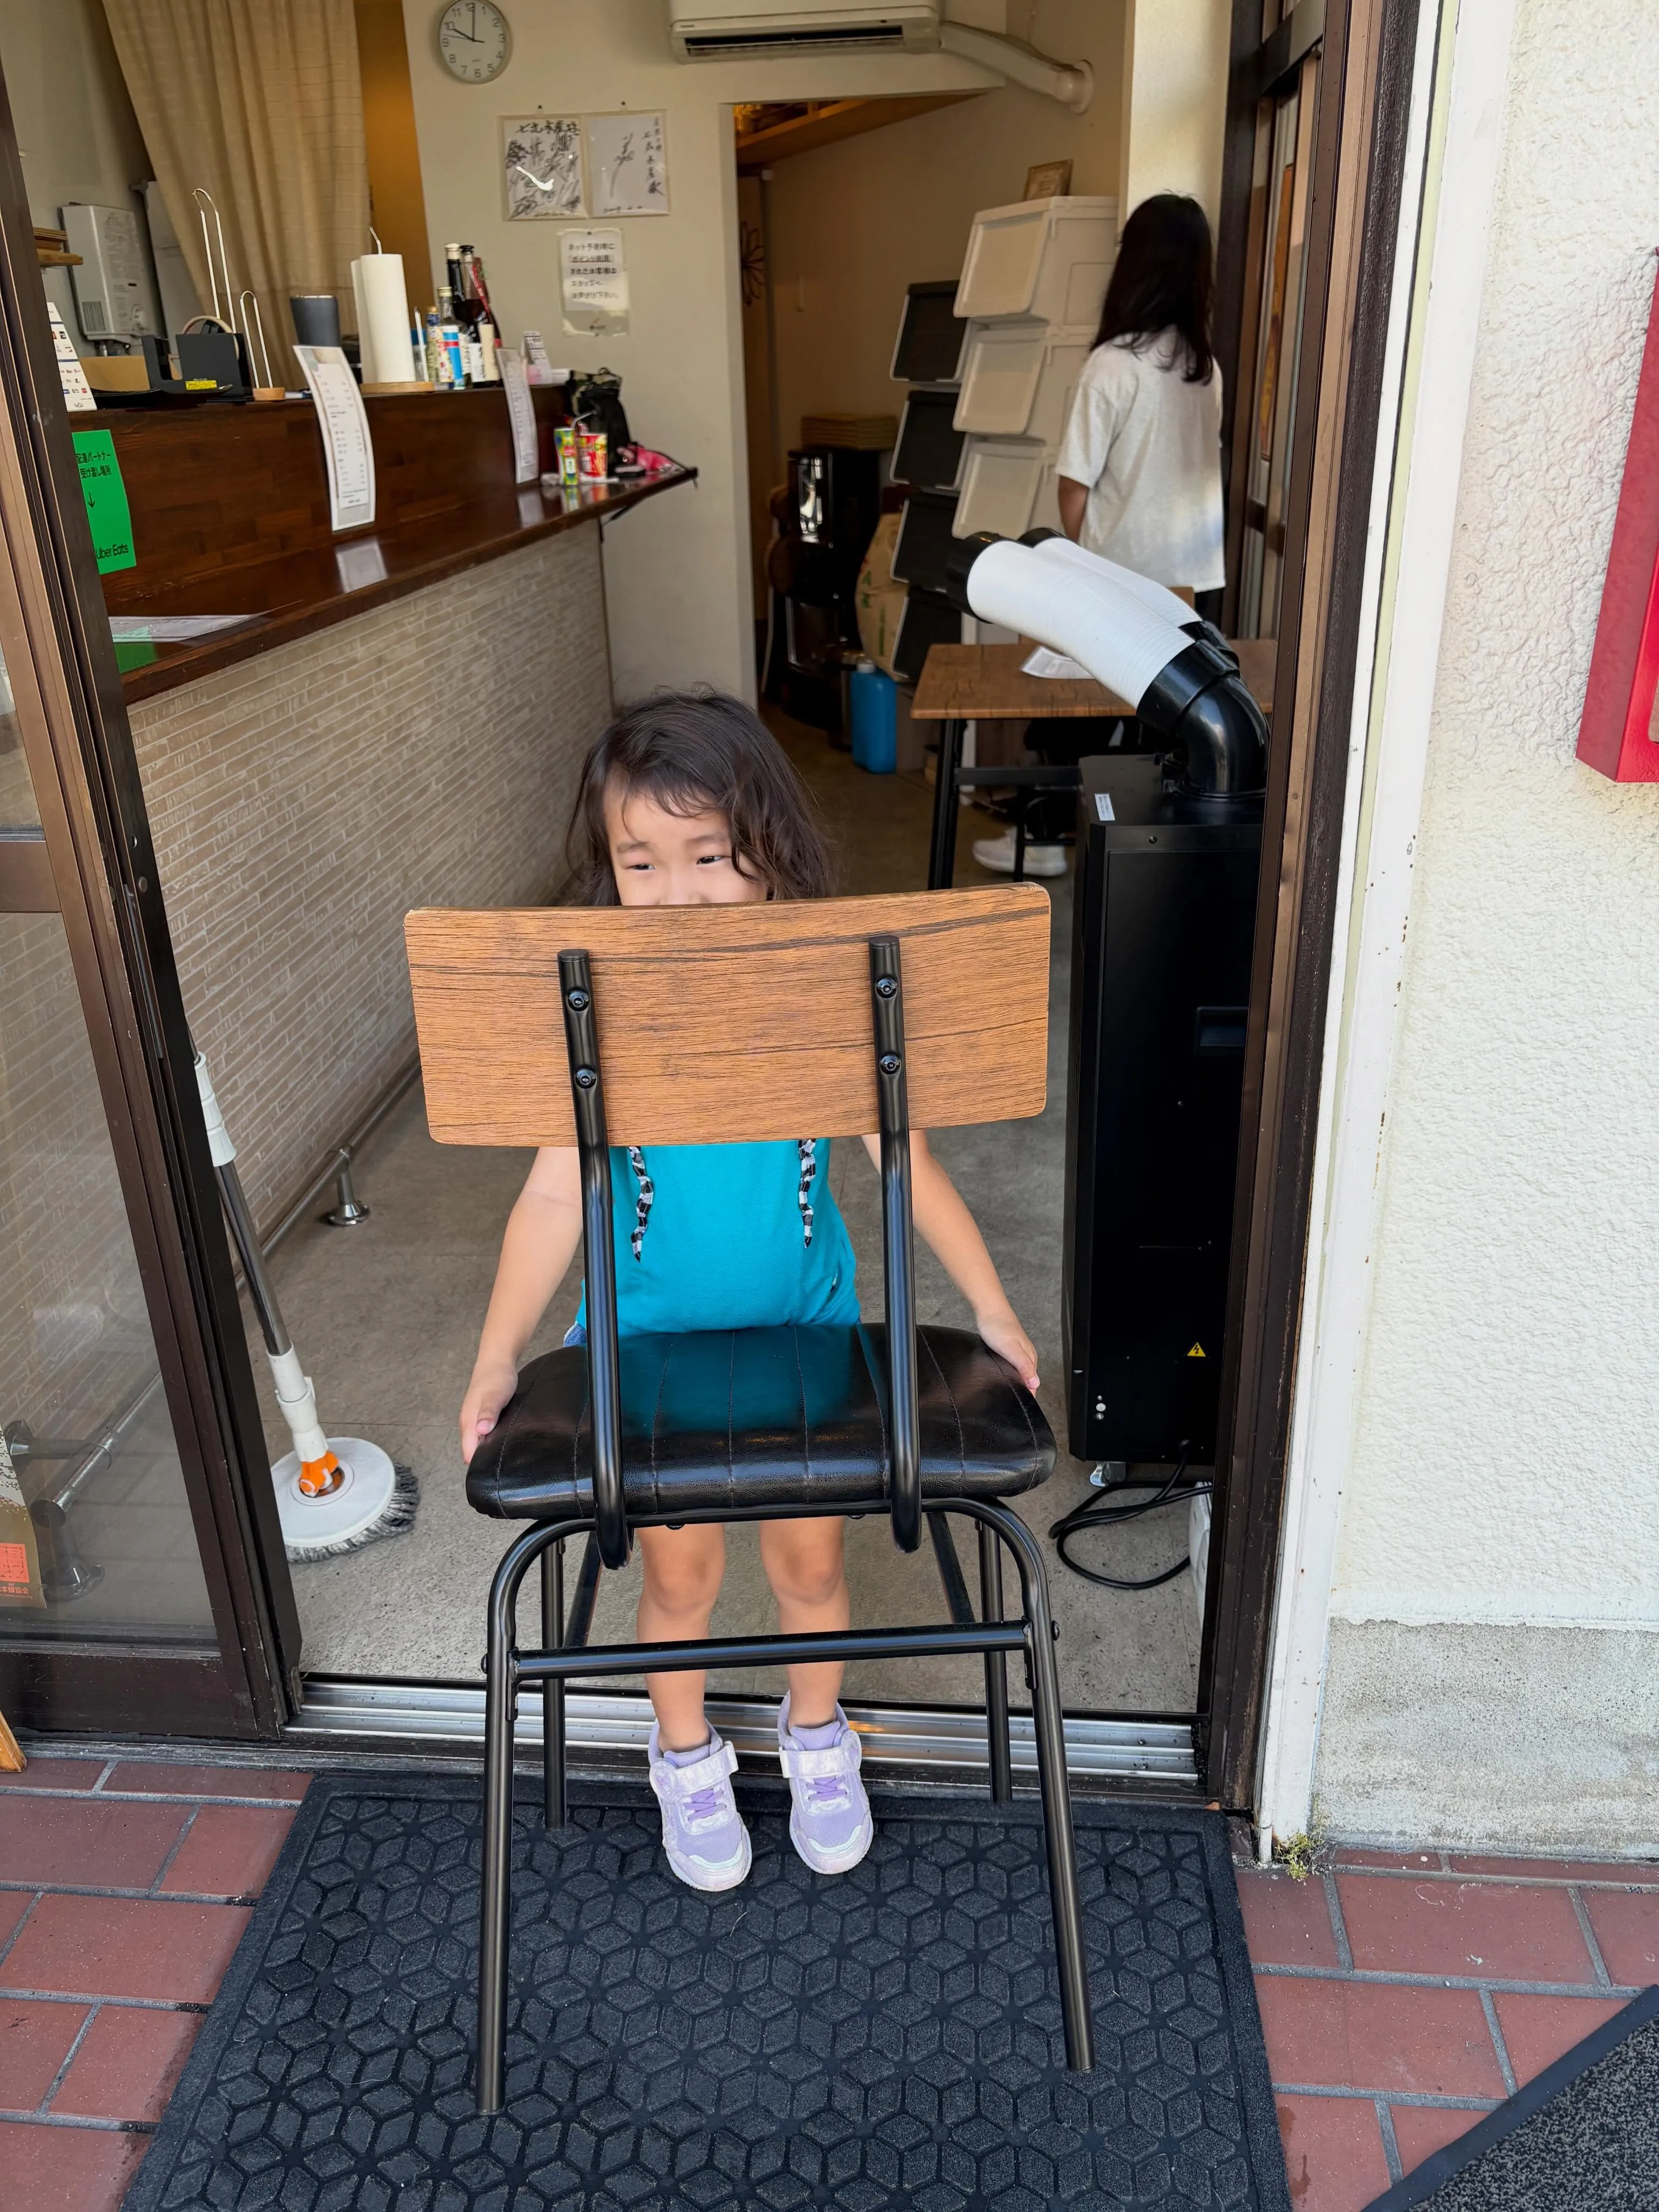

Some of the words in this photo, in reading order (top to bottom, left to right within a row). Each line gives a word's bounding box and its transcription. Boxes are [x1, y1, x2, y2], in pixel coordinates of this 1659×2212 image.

[466, 2, 476, 12] 12
[482, 6, 486, 15] 1
[451, 8, 462, 17] 11
[444, 21, 455, 31] 10
[492, 17, 501, 28] 2
[442, 37, 449, 47] 9
[499, 33, 506, 43] 3
[449, 54, 456, 63] 8
[496, 51, 503, 59] 4
[460, 65, 468, 75] 7
[487, 63, 495, 73] 5
[474, 69, 481, 78] 6
[96, 547, 112, 559] Uber
[112, 543, 129, 557] Eats
